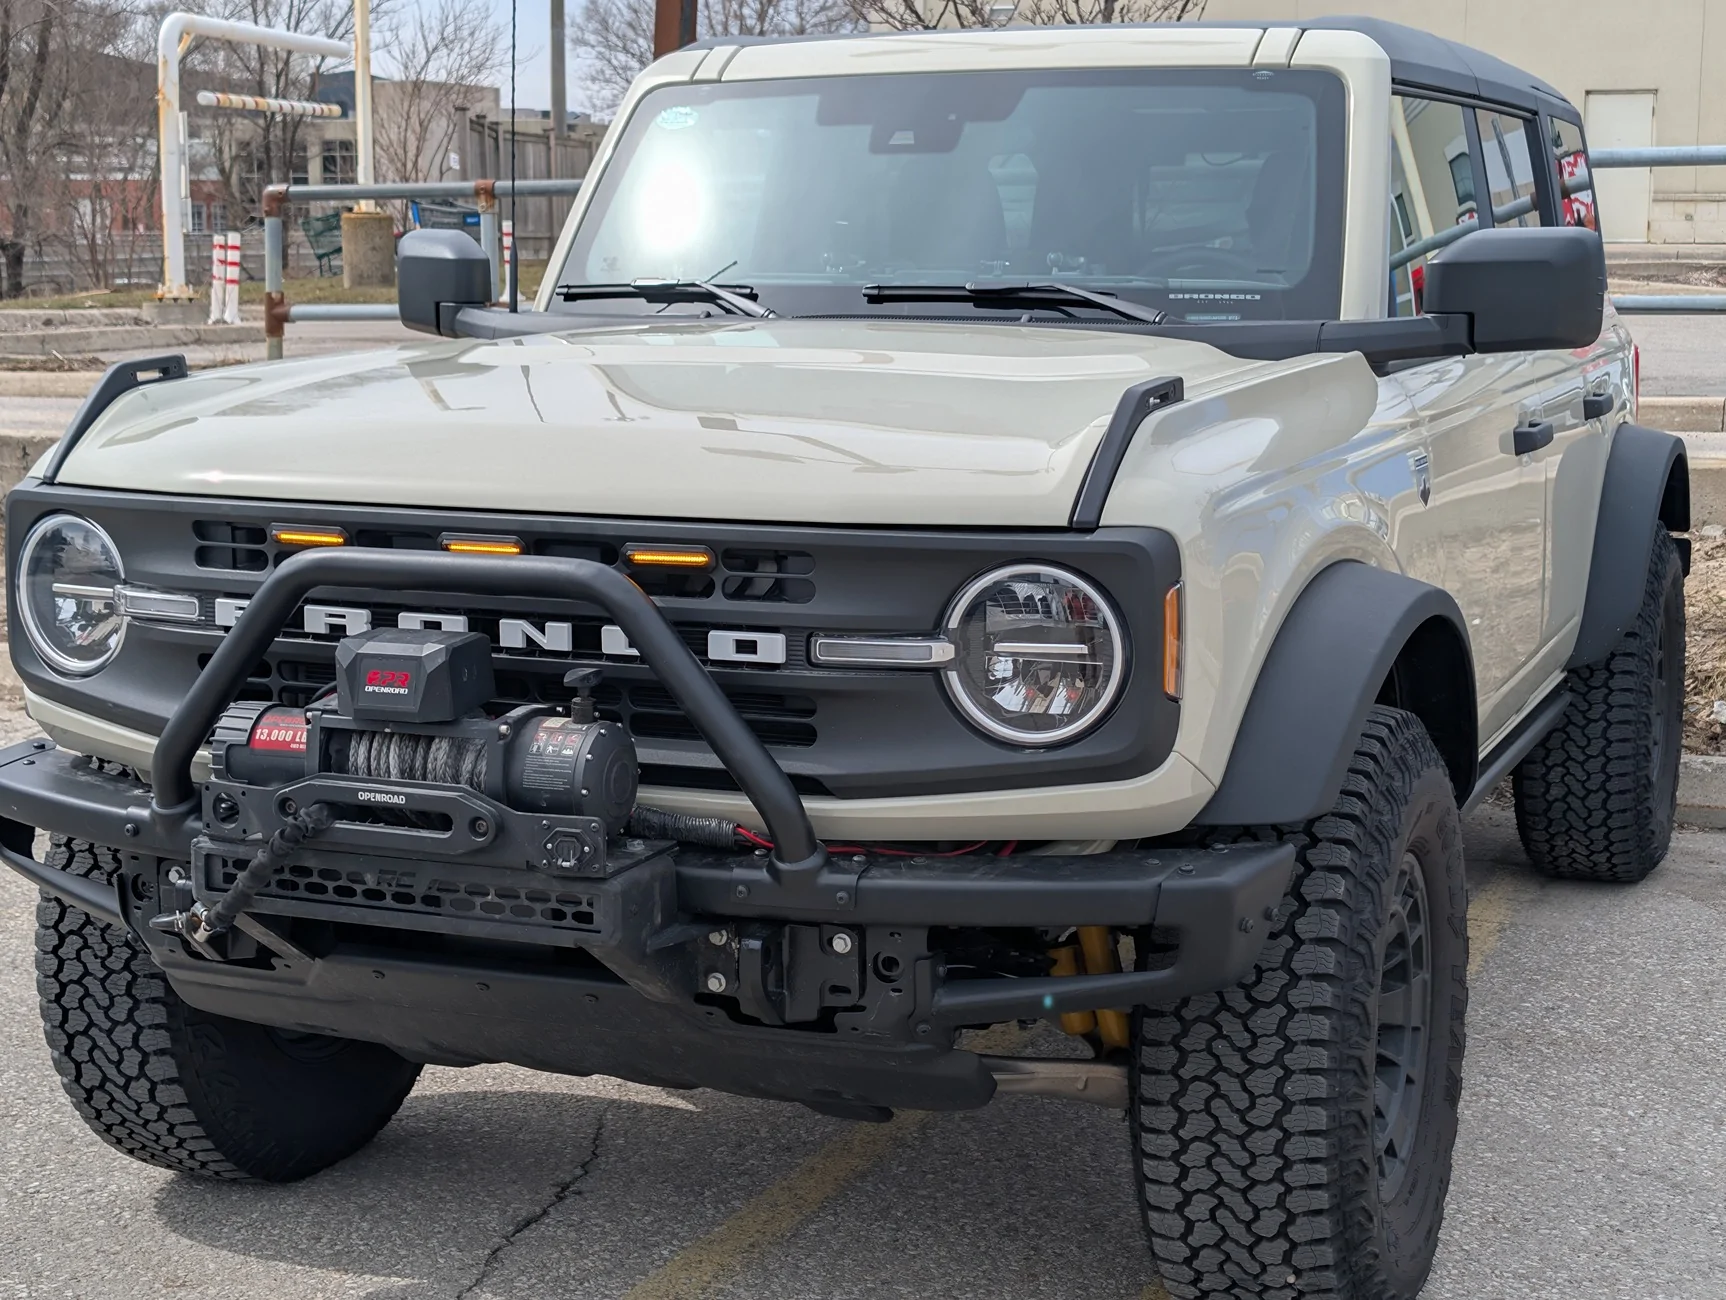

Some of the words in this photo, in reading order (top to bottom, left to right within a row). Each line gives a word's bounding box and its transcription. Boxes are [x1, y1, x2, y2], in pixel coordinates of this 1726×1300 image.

[364, 685, 409, 695] OPENROAD
[255, 728, 294, 742] 13,000
[357, 791, 406, 804] OPENROAD
